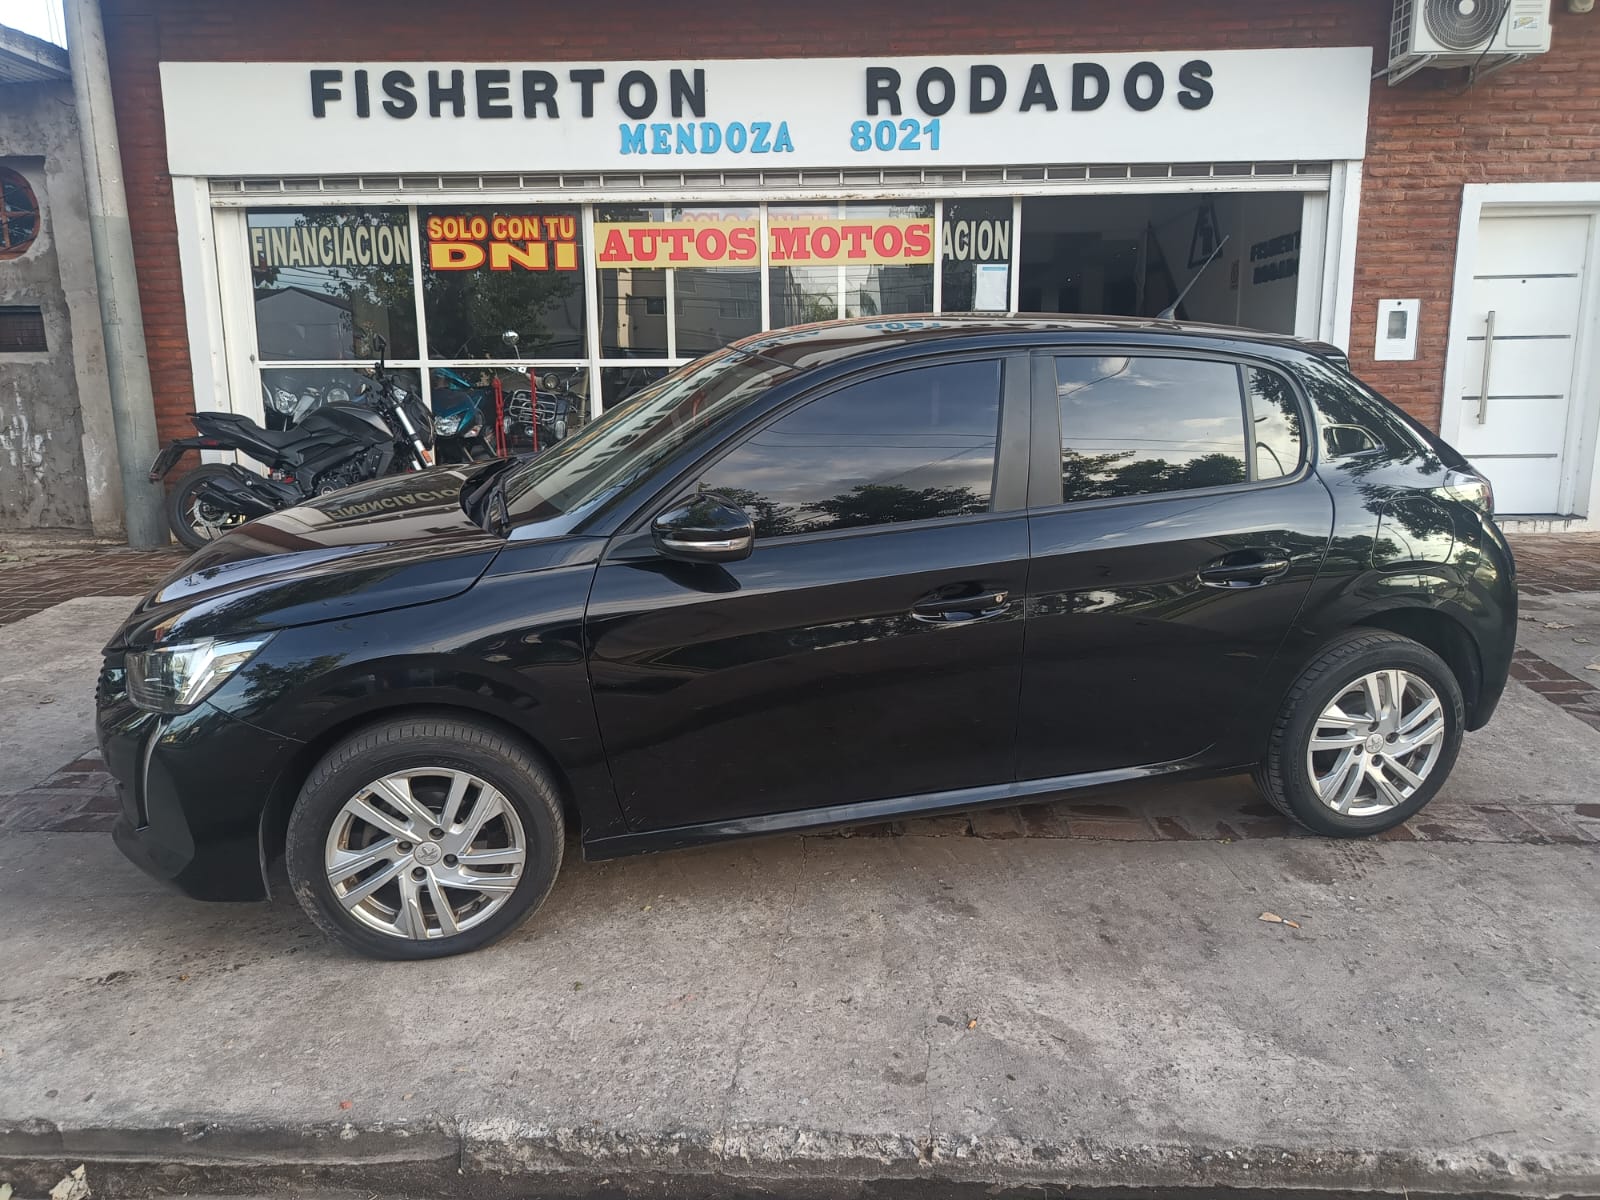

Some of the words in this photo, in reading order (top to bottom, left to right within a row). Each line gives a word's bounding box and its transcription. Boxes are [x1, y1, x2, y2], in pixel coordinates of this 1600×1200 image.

[311, 68, 706, 119] FISHERTON
[866, 60, 1214, 116] RODADOS
[619, 121, 794, 154] MENDOZA
[850, 118, 941, 152] 8021
[428, 216, 488, 240] SOLO
[491, 216, 541, 240] CON
[544, 215, 576, 240] TU
[599, 228, 757, 262] AUTOS
[771, 224, 931, 259] MOTOS
[250, 225, 411, 267] FINANCIACION
[428, 241, 578, 271] DNI
